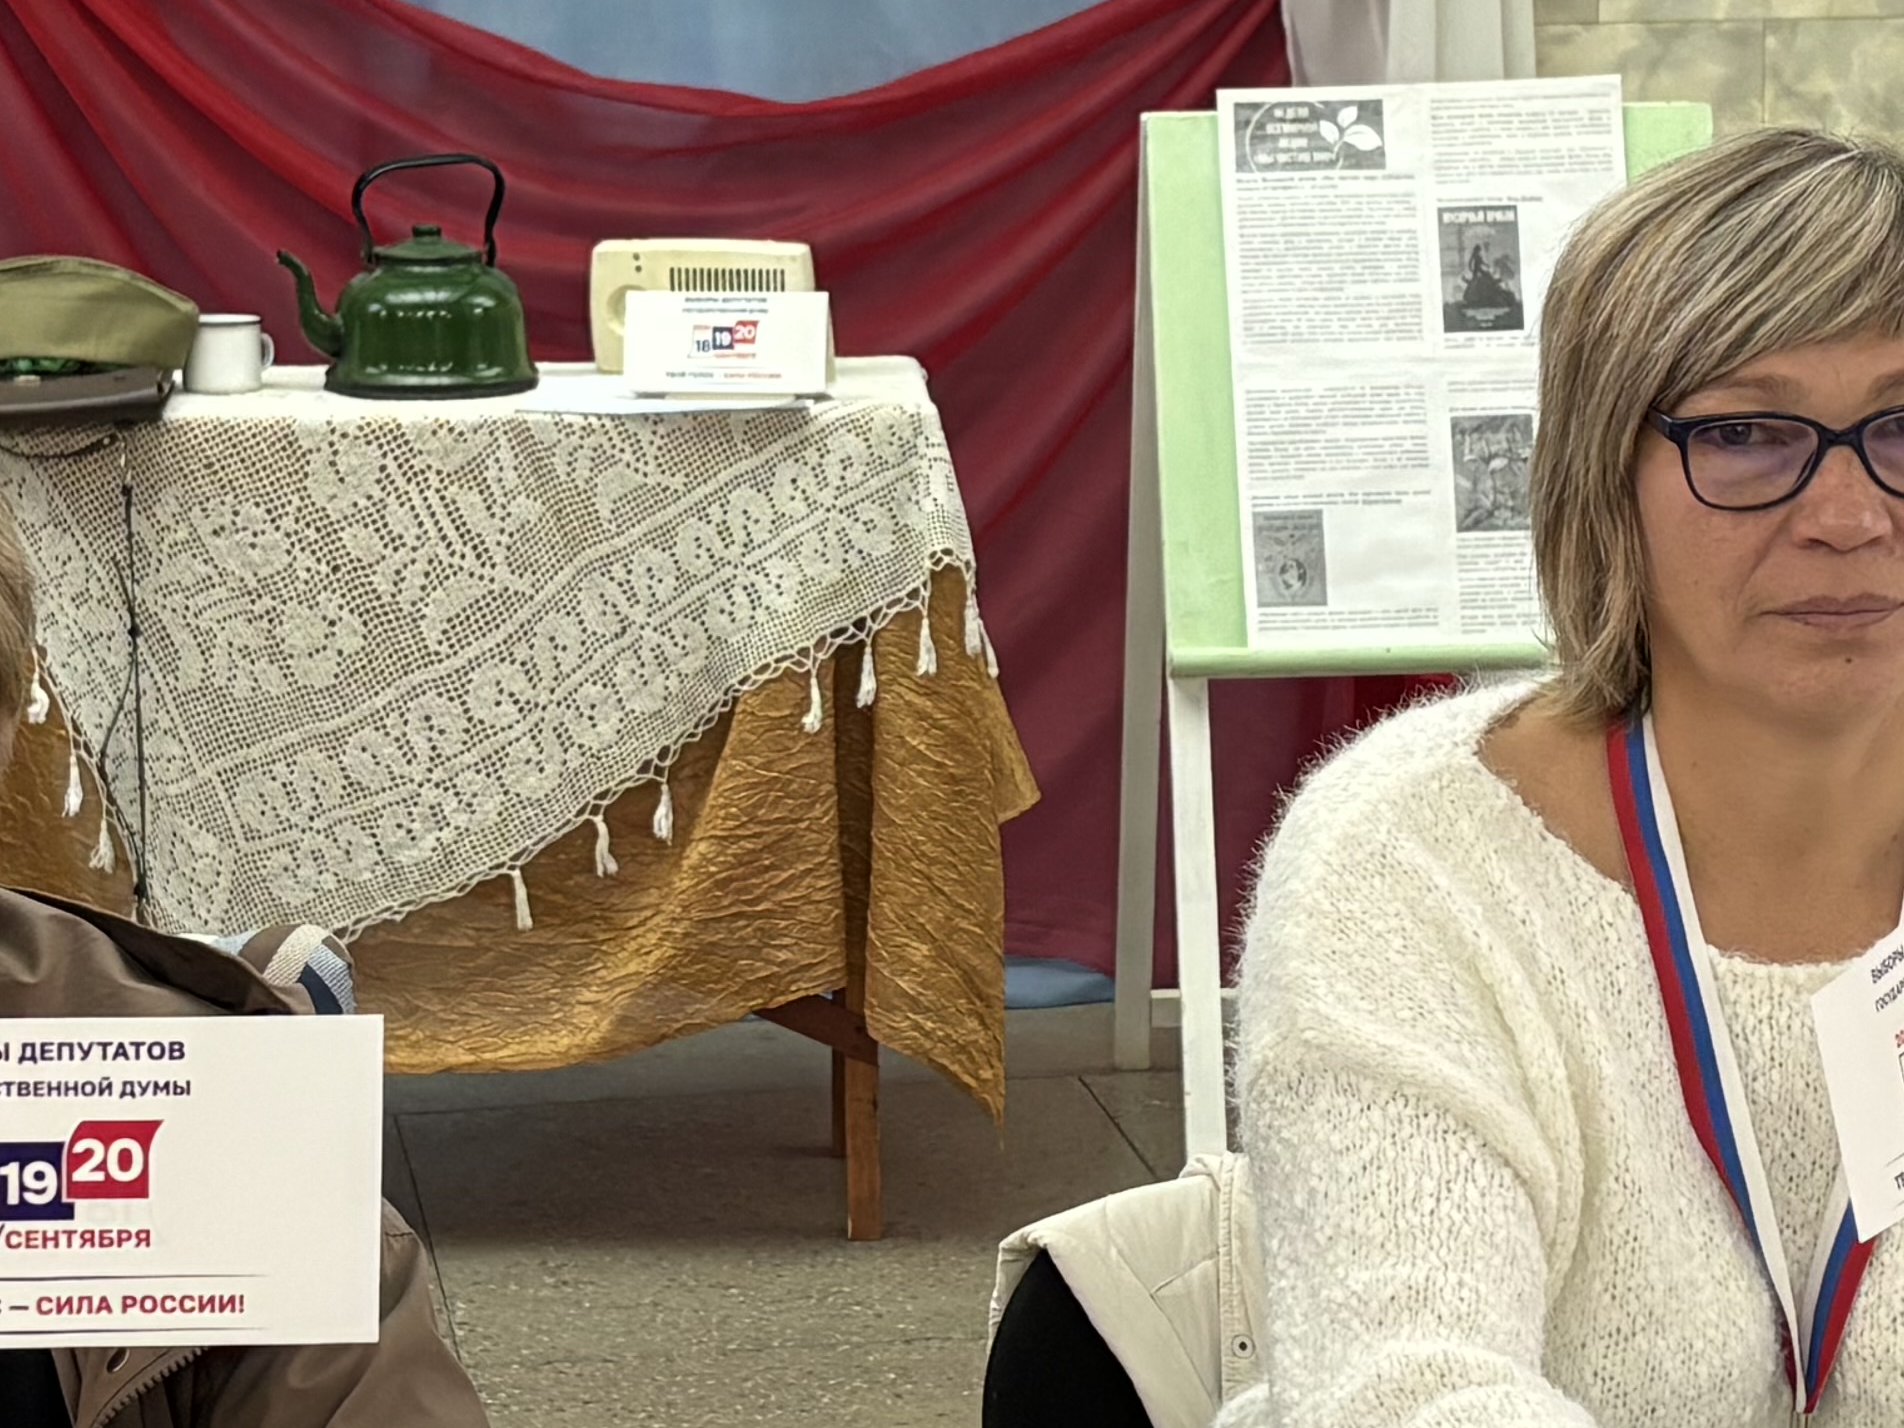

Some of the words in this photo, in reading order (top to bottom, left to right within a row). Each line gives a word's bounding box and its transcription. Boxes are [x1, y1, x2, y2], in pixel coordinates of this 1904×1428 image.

[695, 339, 710, 353] 18
[714, 331, 732, 347] 19
[734, 325, 755, 339] 20
[17, 1039, 186, 1065] ДЕПУТАТОВ
[118, 1078, 191, 1100] ДУМЫ
[72, 1137, 146, 1183] 20
[4, 1228, 152, 1250] СЕНТЯБРЯ
[36, 1295, 113, 1316] СИЛА
[120, 1293, 245, 1315] РОССИИ!
